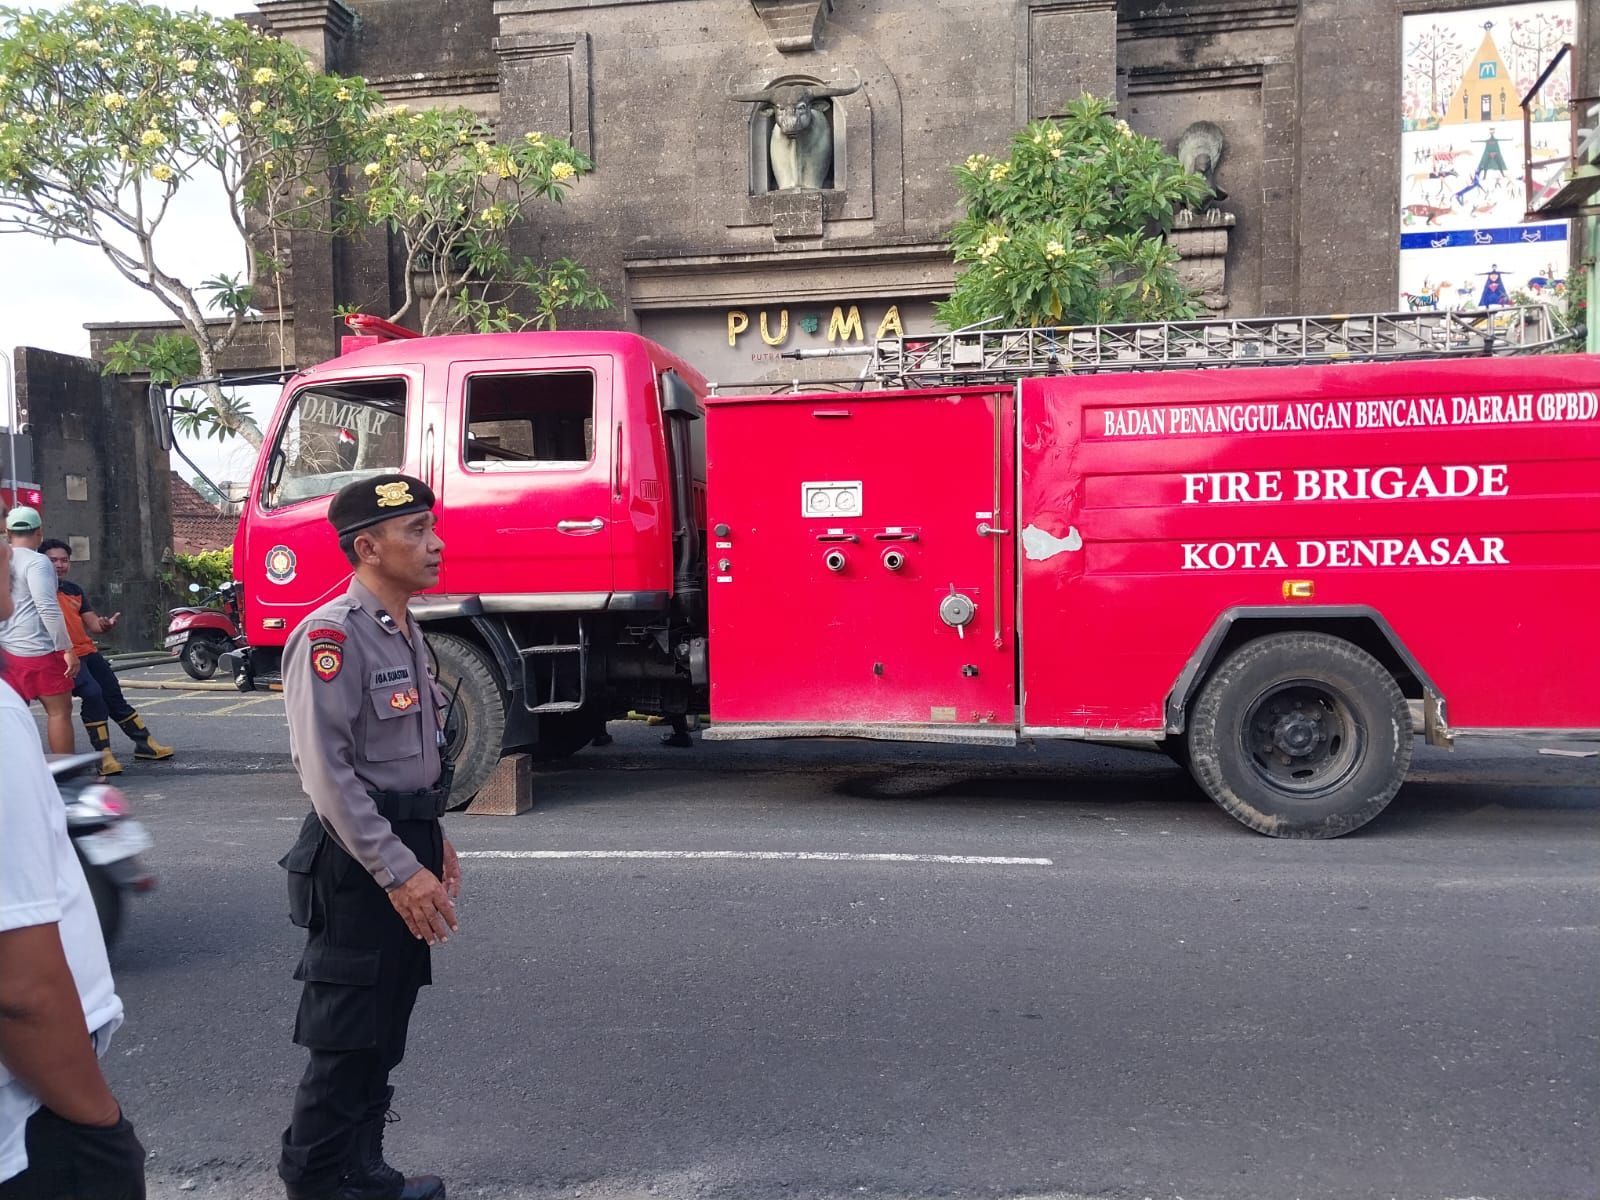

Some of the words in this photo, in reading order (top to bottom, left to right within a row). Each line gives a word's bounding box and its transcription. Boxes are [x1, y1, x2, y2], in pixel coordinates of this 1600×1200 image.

[1103, 408, 1166, 436] BADAN
[1169, 402, 1352, 434] PENANGGULANGAN
[1355, 398, 1448, 428] BENCANA
[1451, 394, 1533, 424] DAERAH
[1536, 391, 1599, 421] (BPBD)
[1181, 470, 1283, 504] FIRE
[1293, 464, 1509, 501] BRIGADE
[1181, 541, 1289, 569] KOTA
[1296, 537, 1510, 567] DENPASAR
